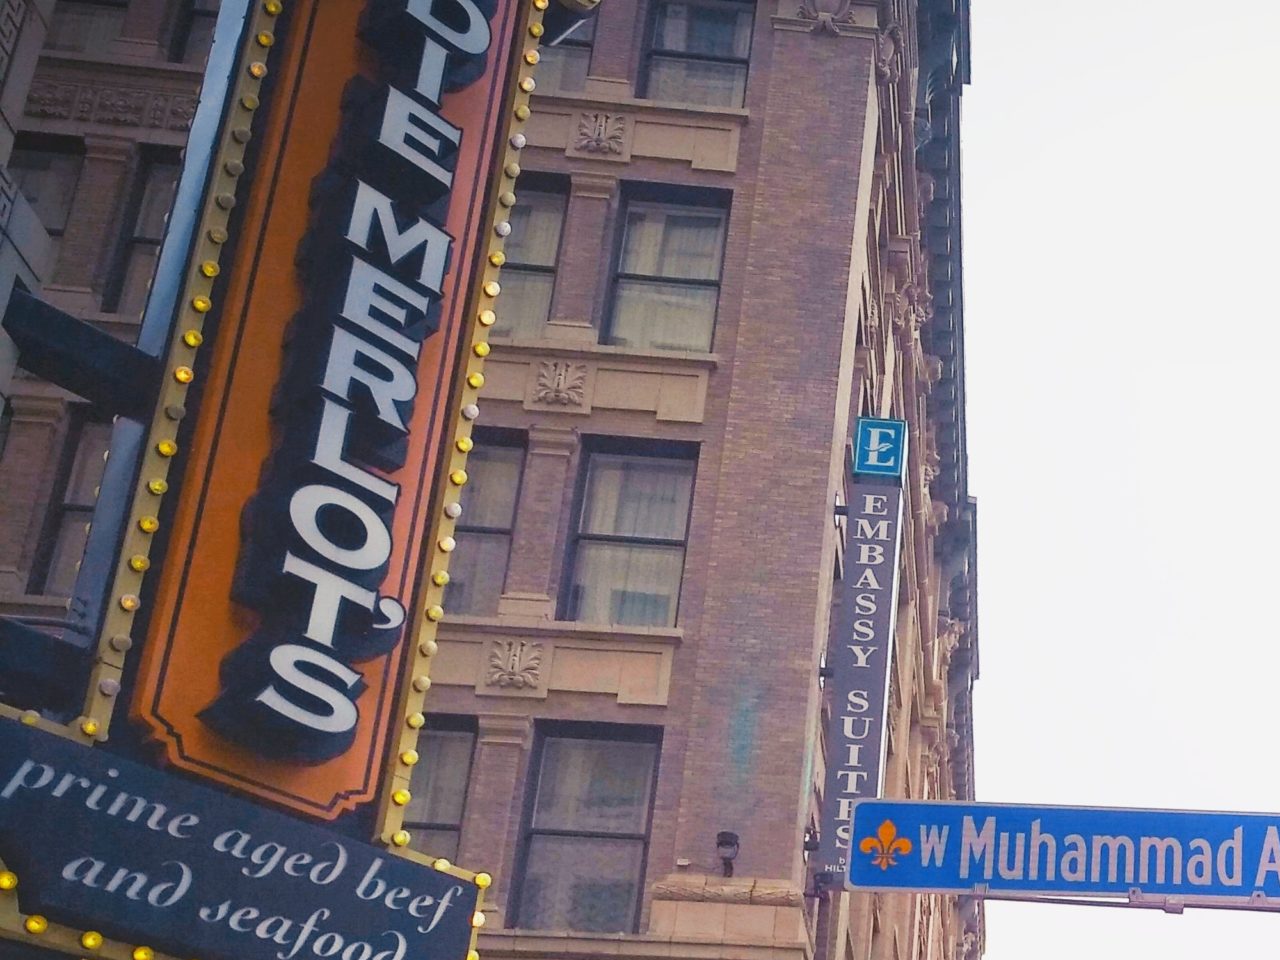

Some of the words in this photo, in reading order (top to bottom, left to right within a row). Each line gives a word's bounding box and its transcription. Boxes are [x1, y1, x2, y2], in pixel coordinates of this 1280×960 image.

[256, 179, 456, 733] MERLOT'S
[848, 494, 893, 668] EMBASSY
[0, 758, 200, 839] prime
[213, 828, 348, 886] aged
[356, 856, 464, 934] beef
[61, 854, 193, 908] and
[824, 864, 847, 873] HILT
[920, 824, 949, 868] W
[960, 815, 1243, 887] Muhammad
